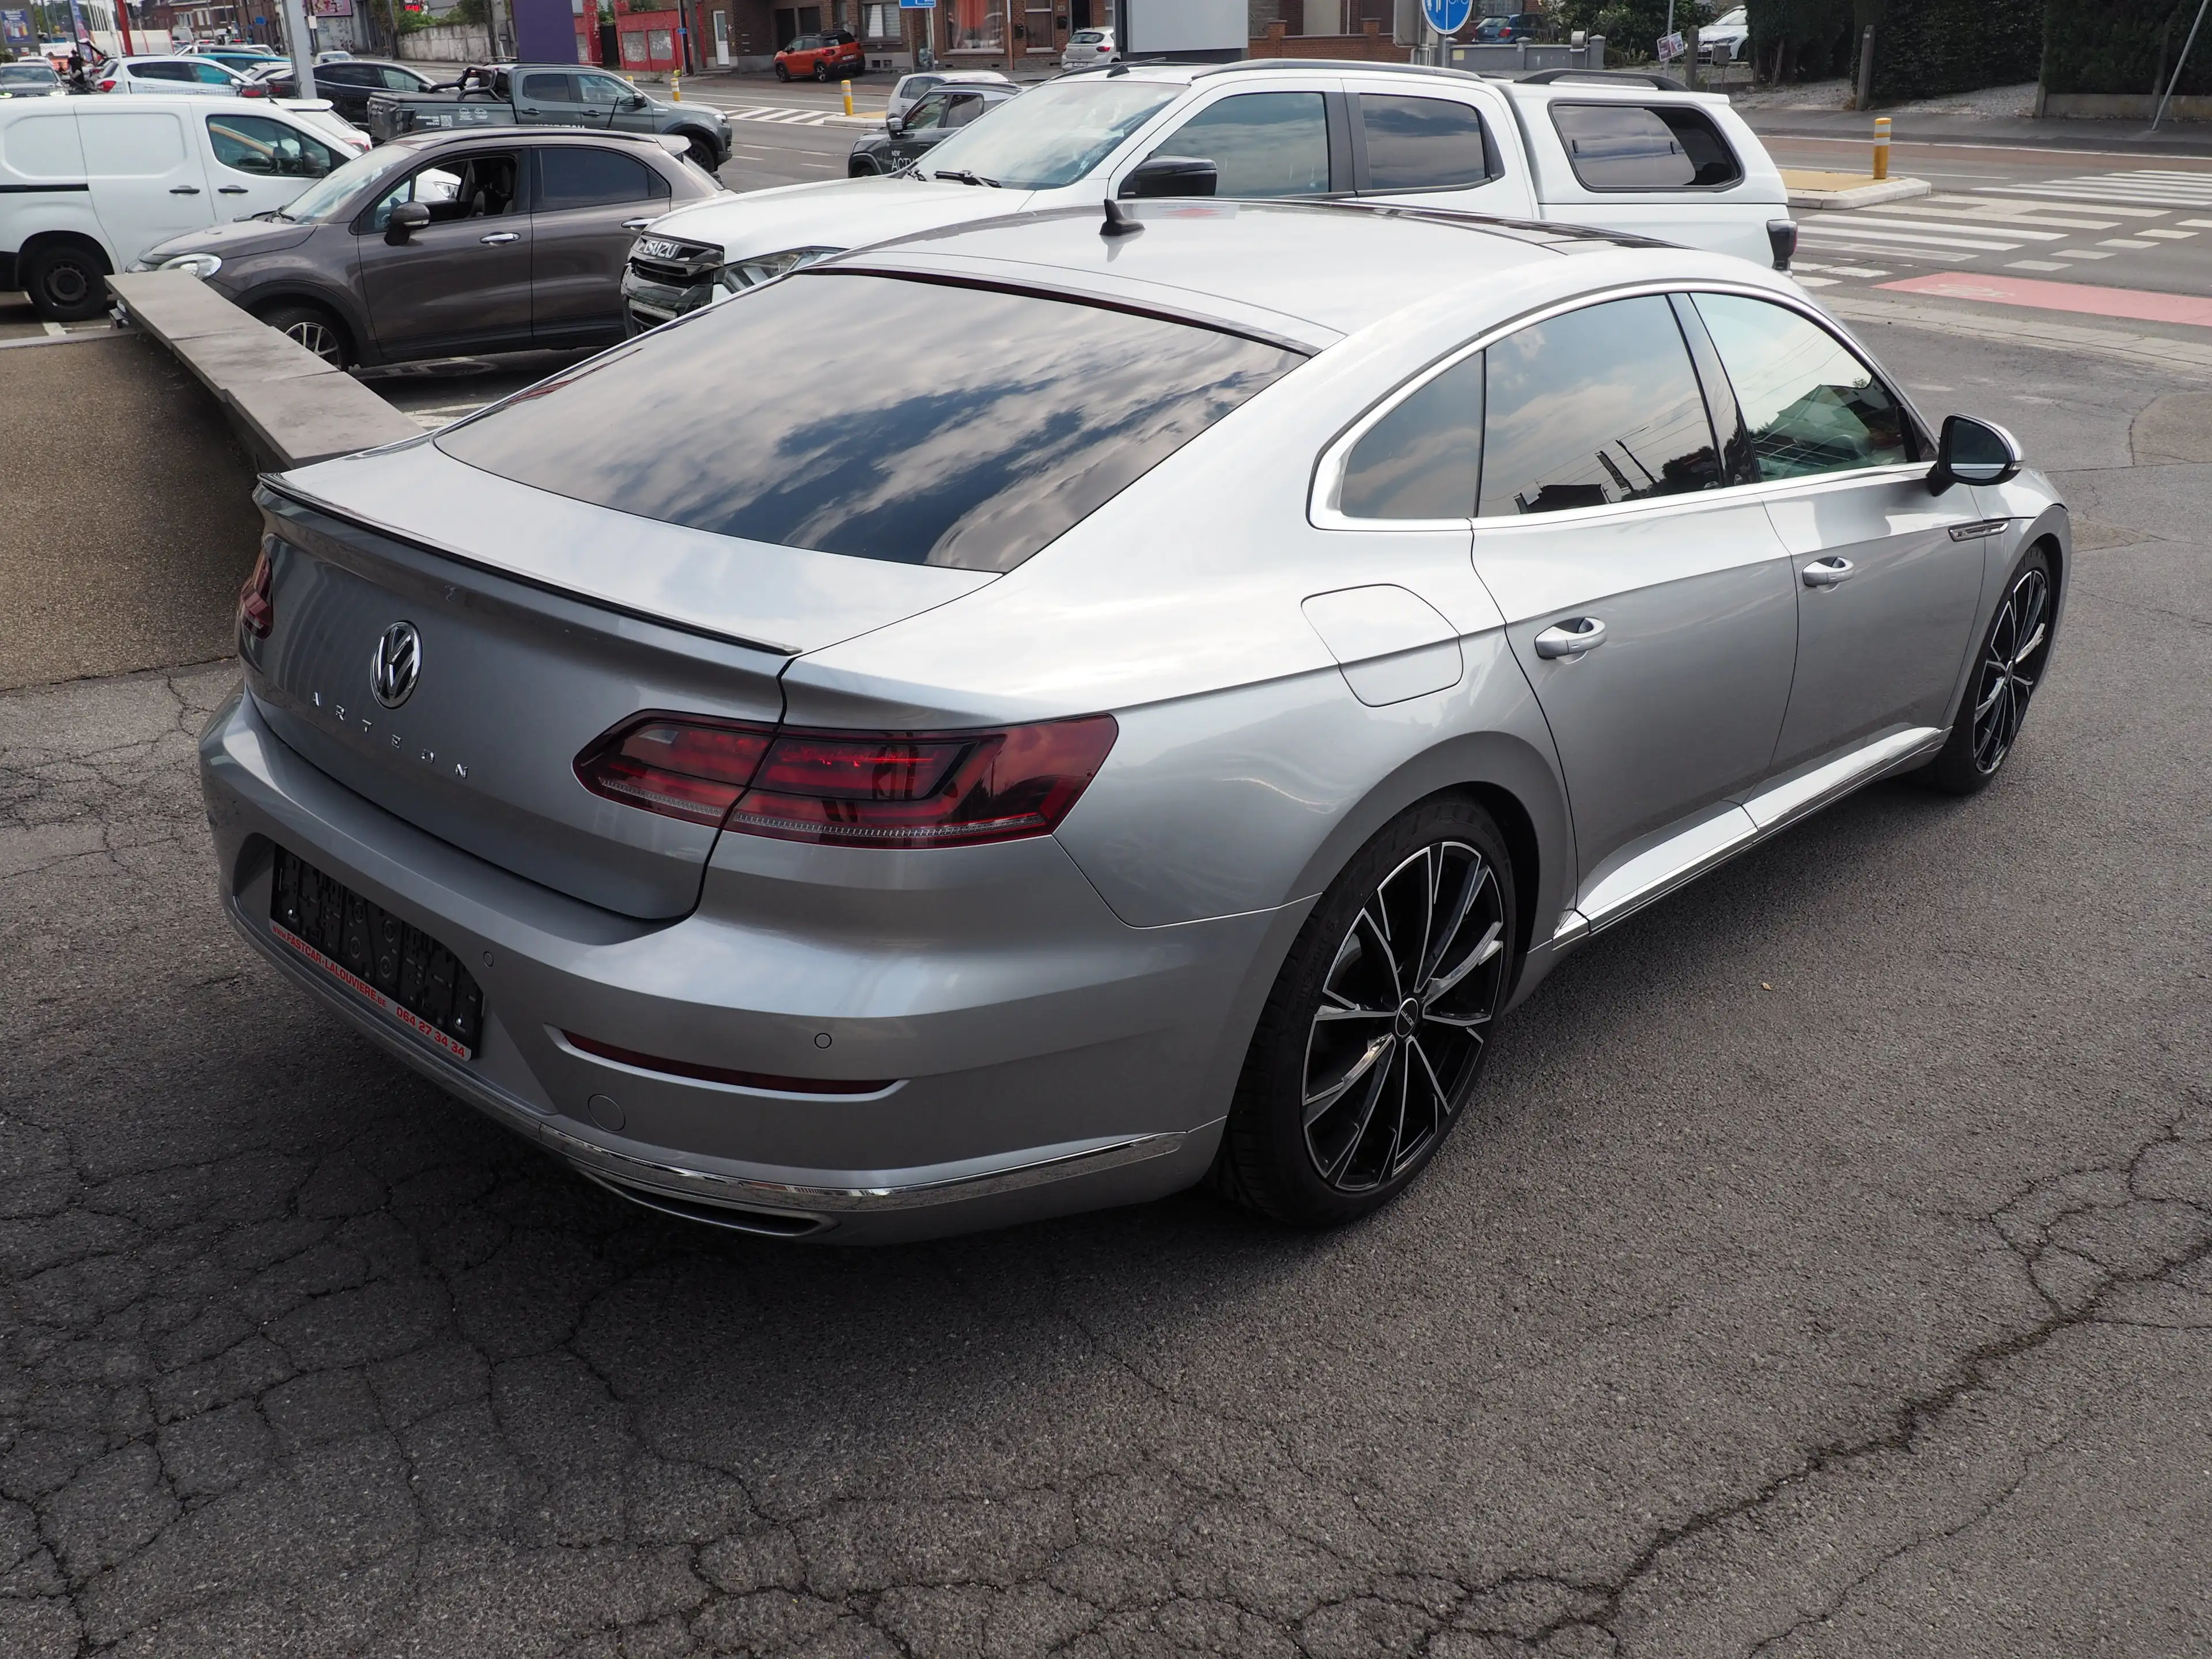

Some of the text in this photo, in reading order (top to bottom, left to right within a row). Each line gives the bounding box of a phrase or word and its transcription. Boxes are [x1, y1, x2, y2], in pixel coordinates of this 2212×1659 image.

[643, 239, 679, 259] ISUZU
[313, 691, 468, 779] ARTEON
[396, 1007, 416, 1027] 064
[418, 1021, 432, 1036] 27
[434, 1031, 448, 1047] 34
[450, 1041, 465, 1058] 34
